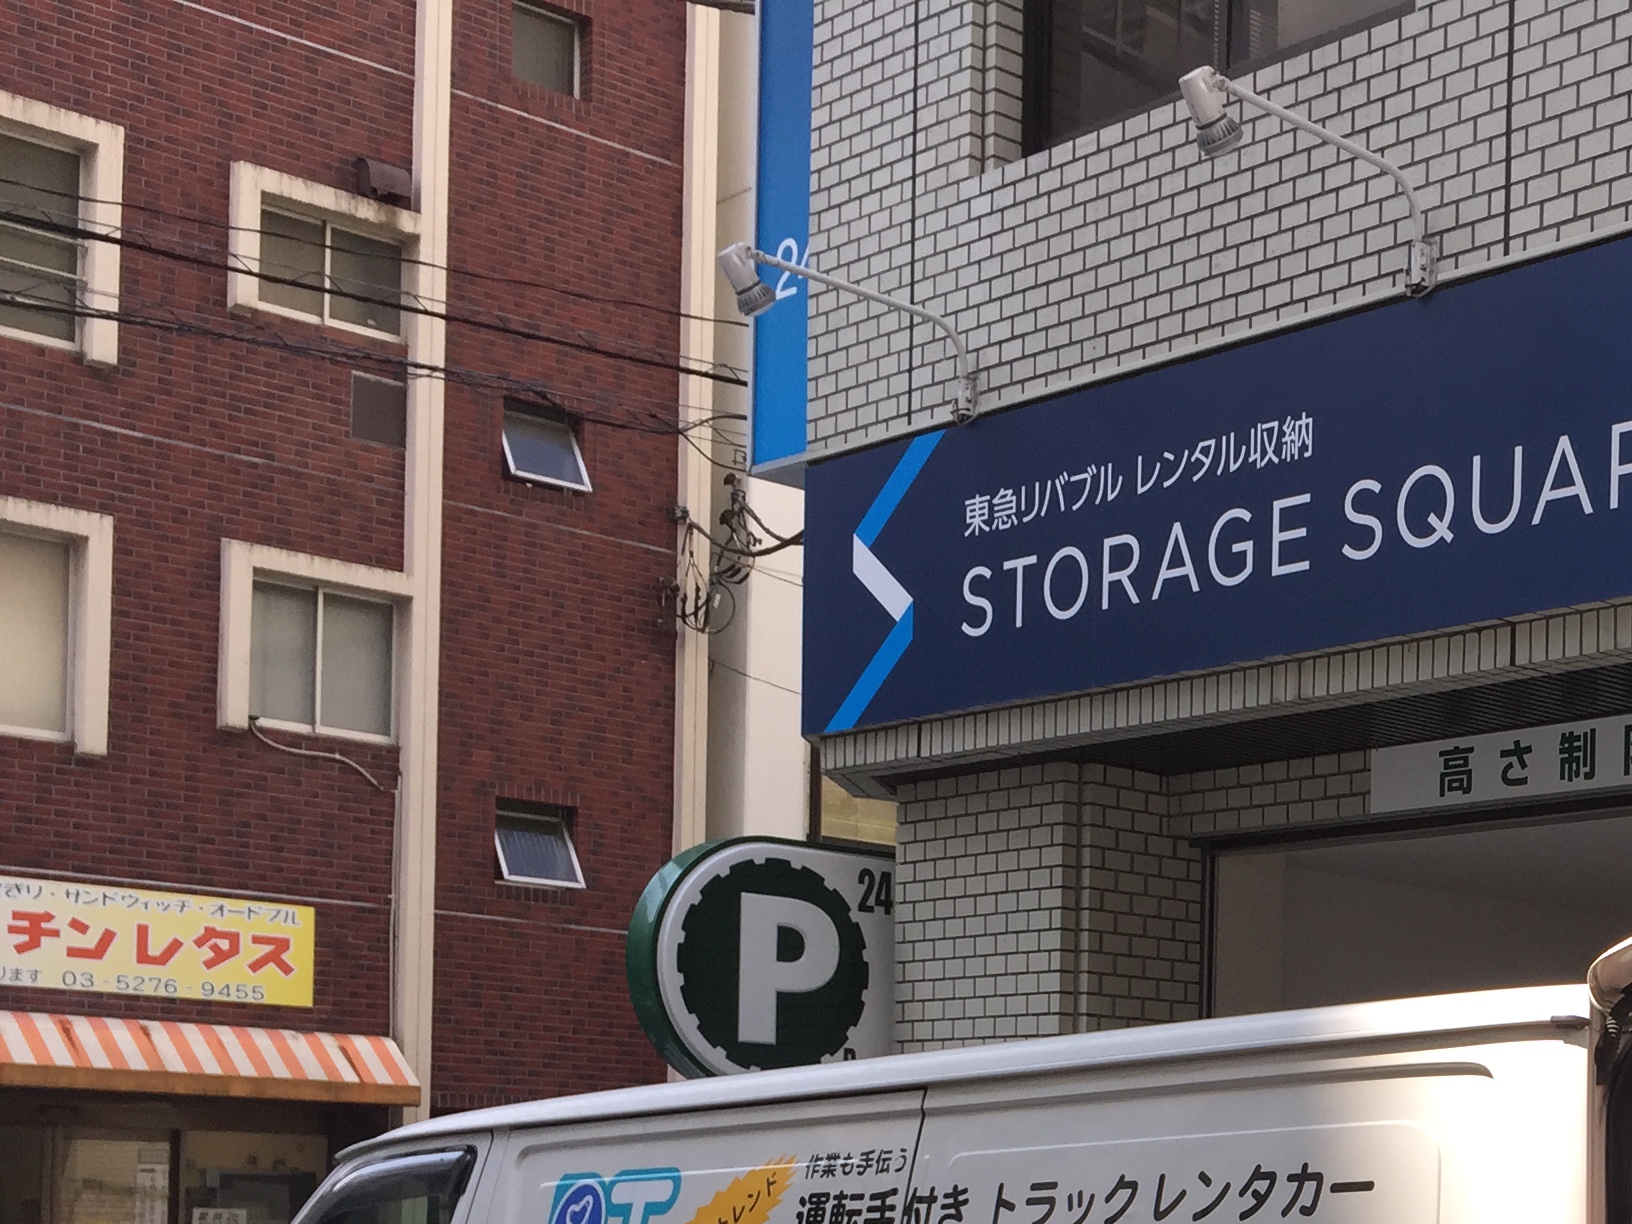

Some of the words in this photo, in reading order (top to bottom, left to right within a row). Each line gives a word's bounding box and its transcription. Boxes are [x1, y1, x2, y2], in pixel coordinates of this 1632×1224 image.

[964, 462, 1123, 538] 東急リバブル
[1137, 411, 1313, 495] レンタル収納
[961, 493, 1312, 637] STORAGE
[62, 970, 265, 1000] 03-5276-9455
[738, 892, 840, 1045] P
[804, 1148, 908, 1180] 作業も手伝う
